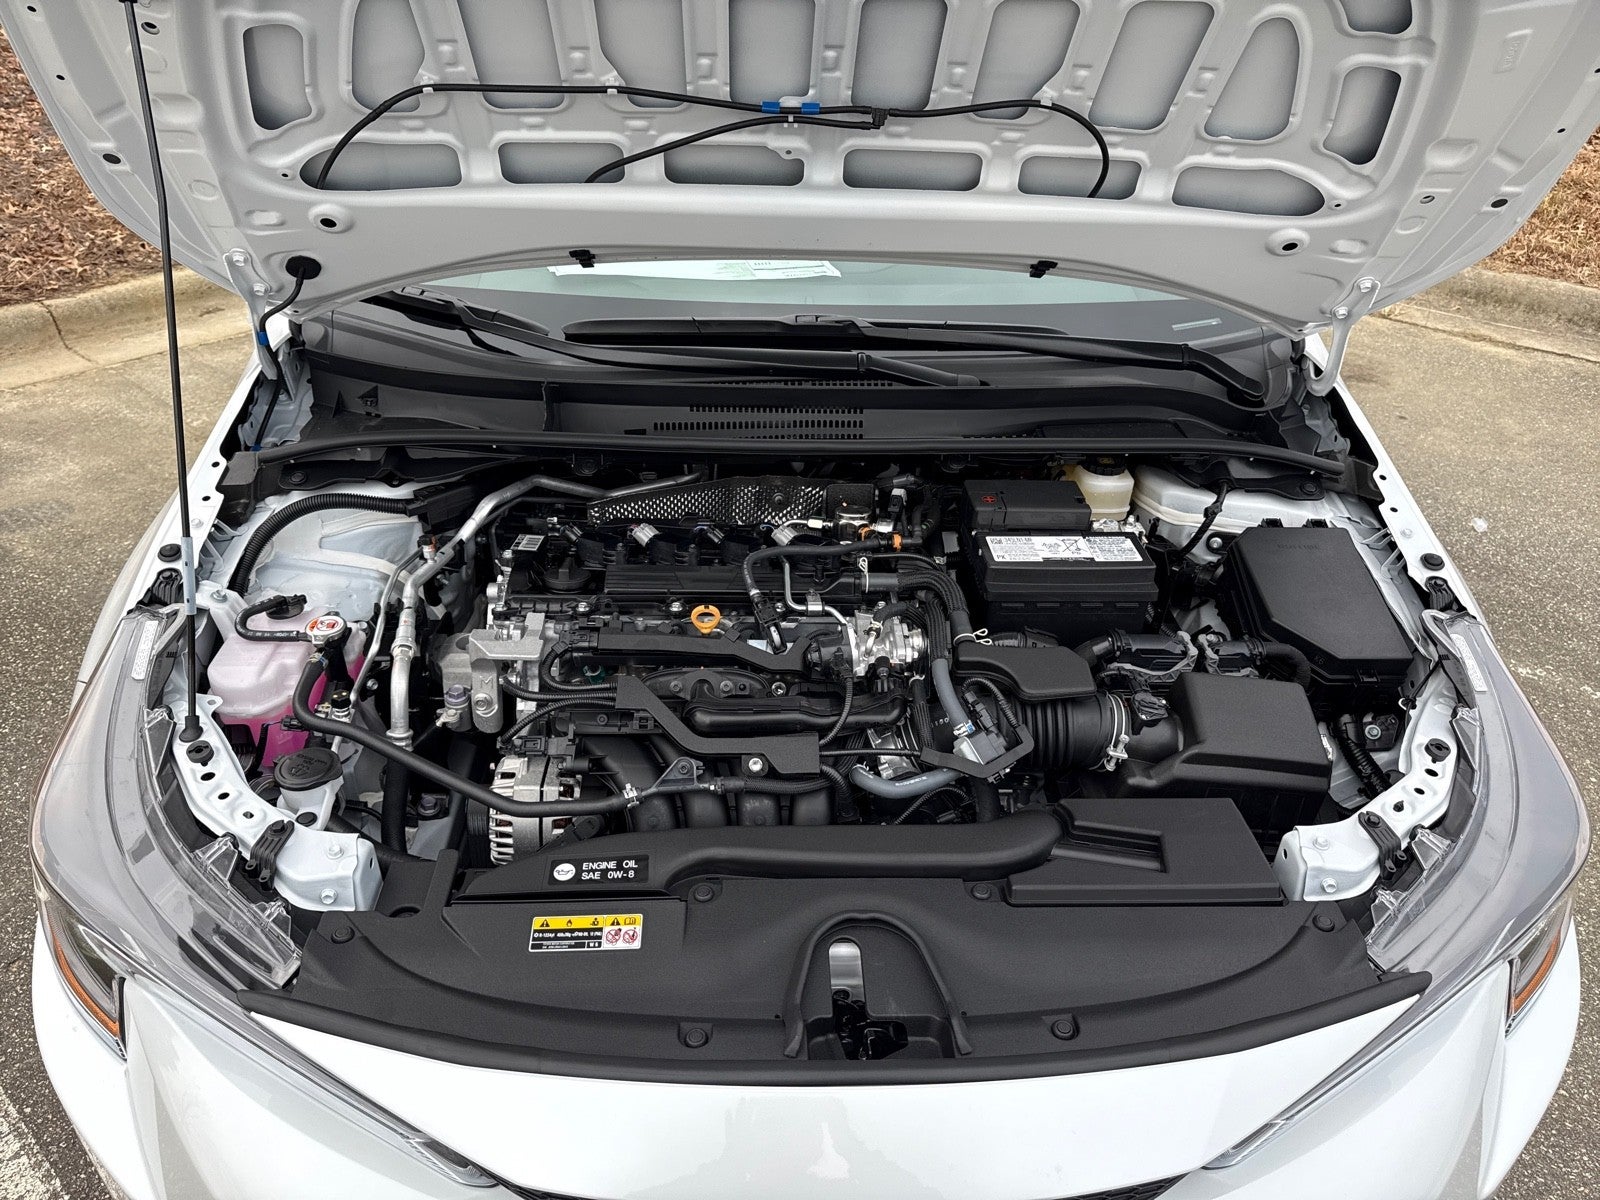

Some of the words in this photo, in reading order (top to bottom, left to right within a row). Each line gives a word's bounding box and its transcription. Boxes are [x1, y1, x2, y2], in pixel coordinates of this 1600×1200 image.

[582, 860, 617, 870] ENGINE
[623, 859, 638, 868] OIL
[581, 871, 601, 880] SAE
[607, 870, 635, 879] 0W-8
